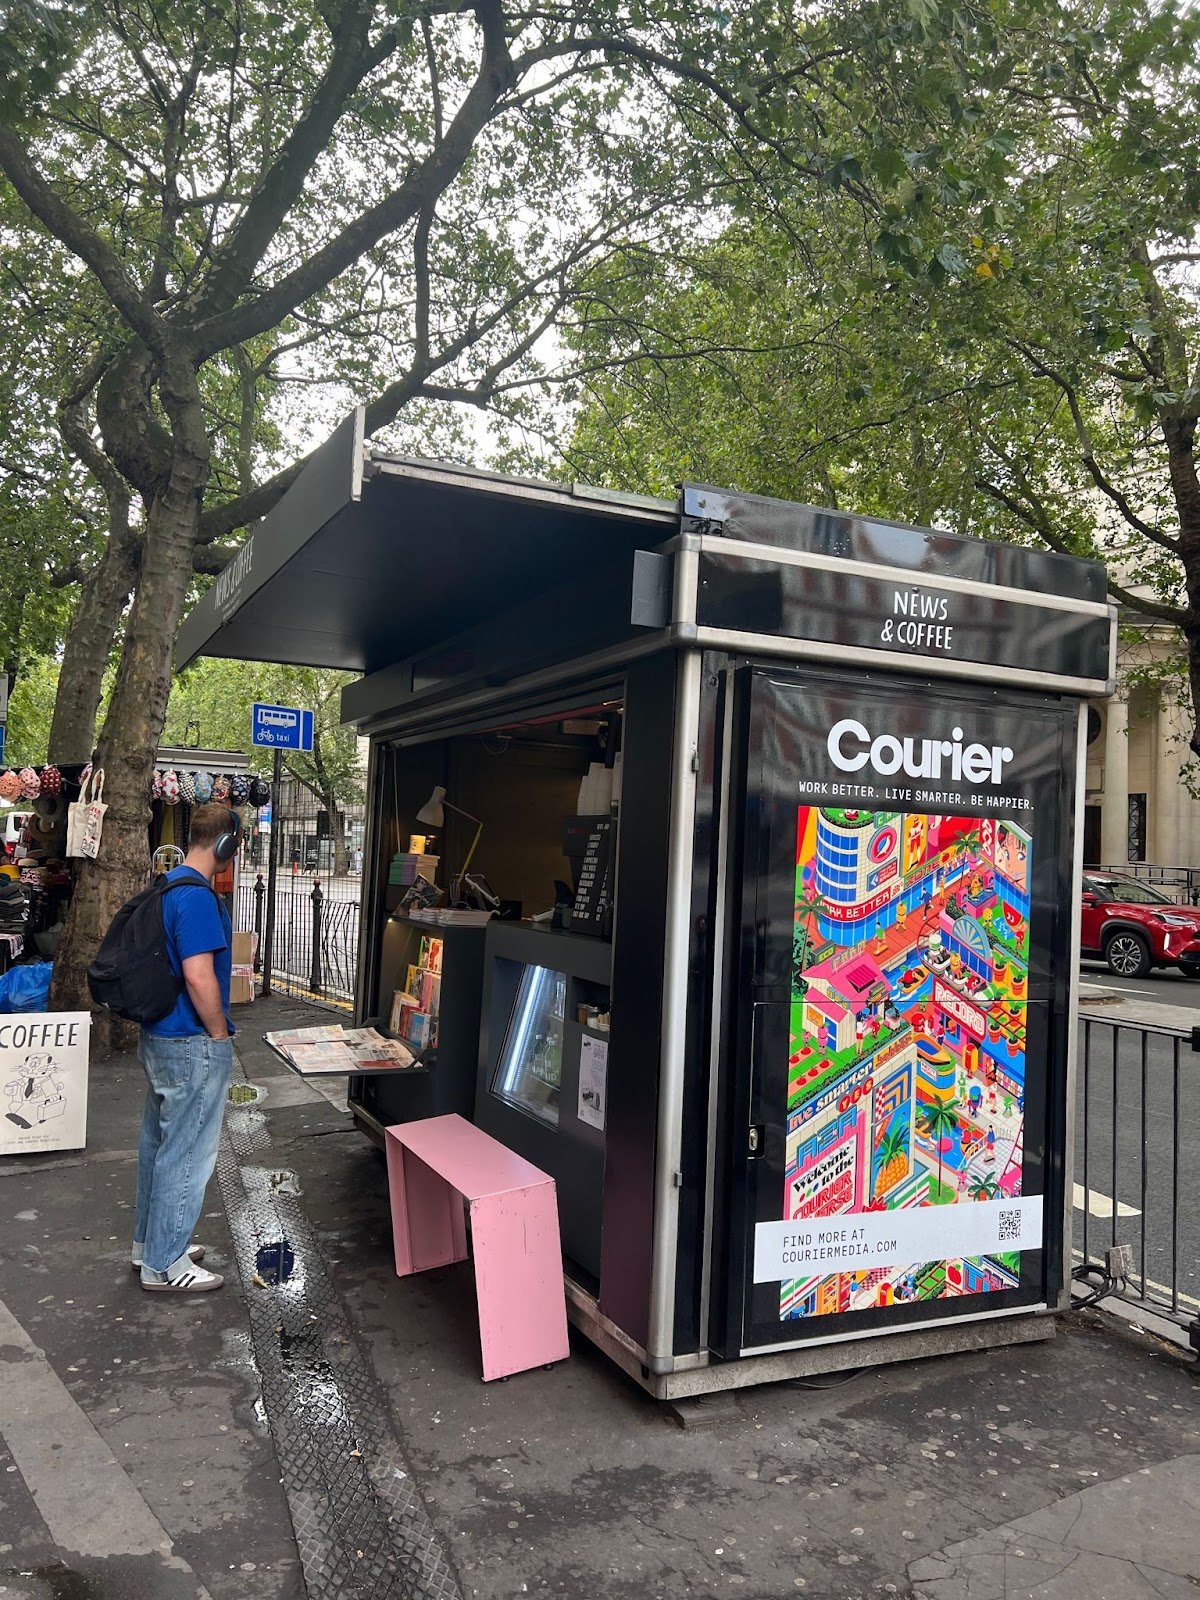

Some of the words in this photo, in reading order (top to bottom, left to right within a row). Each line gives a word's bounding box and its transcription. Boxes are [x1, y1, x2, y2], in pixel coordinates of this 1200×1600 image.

[893, 590, 949, 621] NEWS
[880, 618, 894, 643] &
[897, 621, 954, 650] COFFEE
[276, 732, 290, 743] taxi
[827, 718, 1014, 785] Courier
[799, 781, 829, 795] WORK
[832, 784, 880, 799] BETTER.
[885, 788, 912, 801] LIVE
[915, 790, 967, 806] SMARTER.
[971, 794, 984, 806] BE
[987, 796, 1035, 811] HAPPIER.
[846, 891, 890, 919] BETTER
[935, 981, 985, 1036] RECORD
[0, 1022, 80, 1049] COFFEE
[816, 1062, 873, 1112] smarter
[840, 1080, 872, 1110] YES
[793, 1146, 850, 1193] Welcome
[821, 1171, 834, 1187] to
[835, 1156, 854, 1177] the
[813, 1184, 853, 1218] ERSE
[782, 1239, 898, 1264] COURIERMEDIA.COM
[783, 1234, 812, 1248] FIND
[818, 1230, 847, 1244] MORE
[851, 1228, 865, 1241] AT
